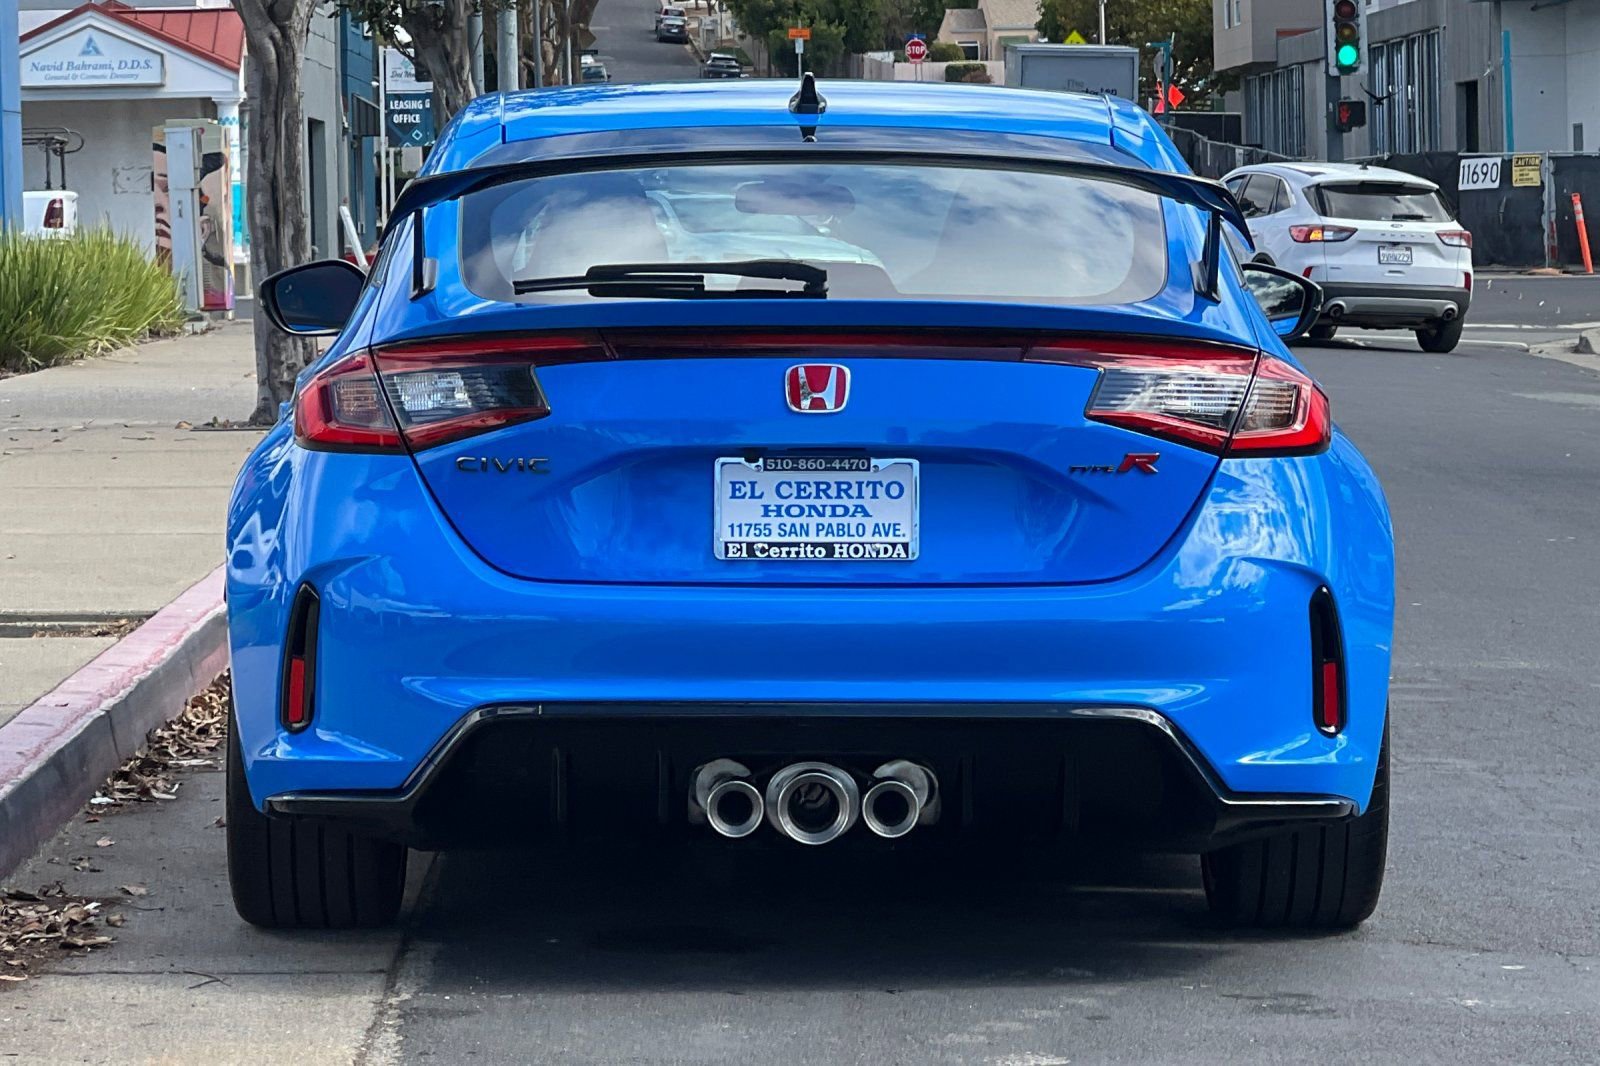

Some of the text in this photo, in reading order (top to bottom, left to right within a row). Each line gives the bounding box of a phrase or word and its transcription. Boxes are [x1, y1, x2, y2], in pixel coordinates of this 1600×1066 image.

[907, 45, 926, 55] STOP
[30, 58, 153, 72] Navid Bahrami, D.D.S.
[390, 100, 423, 110] LEASING
[393, 114, 421, 124] OFFICE
[1461, 162, 1499, 185] 11690
[456, 456, 551, 474] CIVIC
[766, 458, 869, 471] 510-860-4470
[1116, 452, 1160, 475] R
[729, 480, 905, 500] EL CERRITO
[761, 504, 873, 518] HONDA
[728, 523, 906, 538] 11755 SAN PABLO AVE.
[727, 543, 907, 559] El Cerrito HONDA
